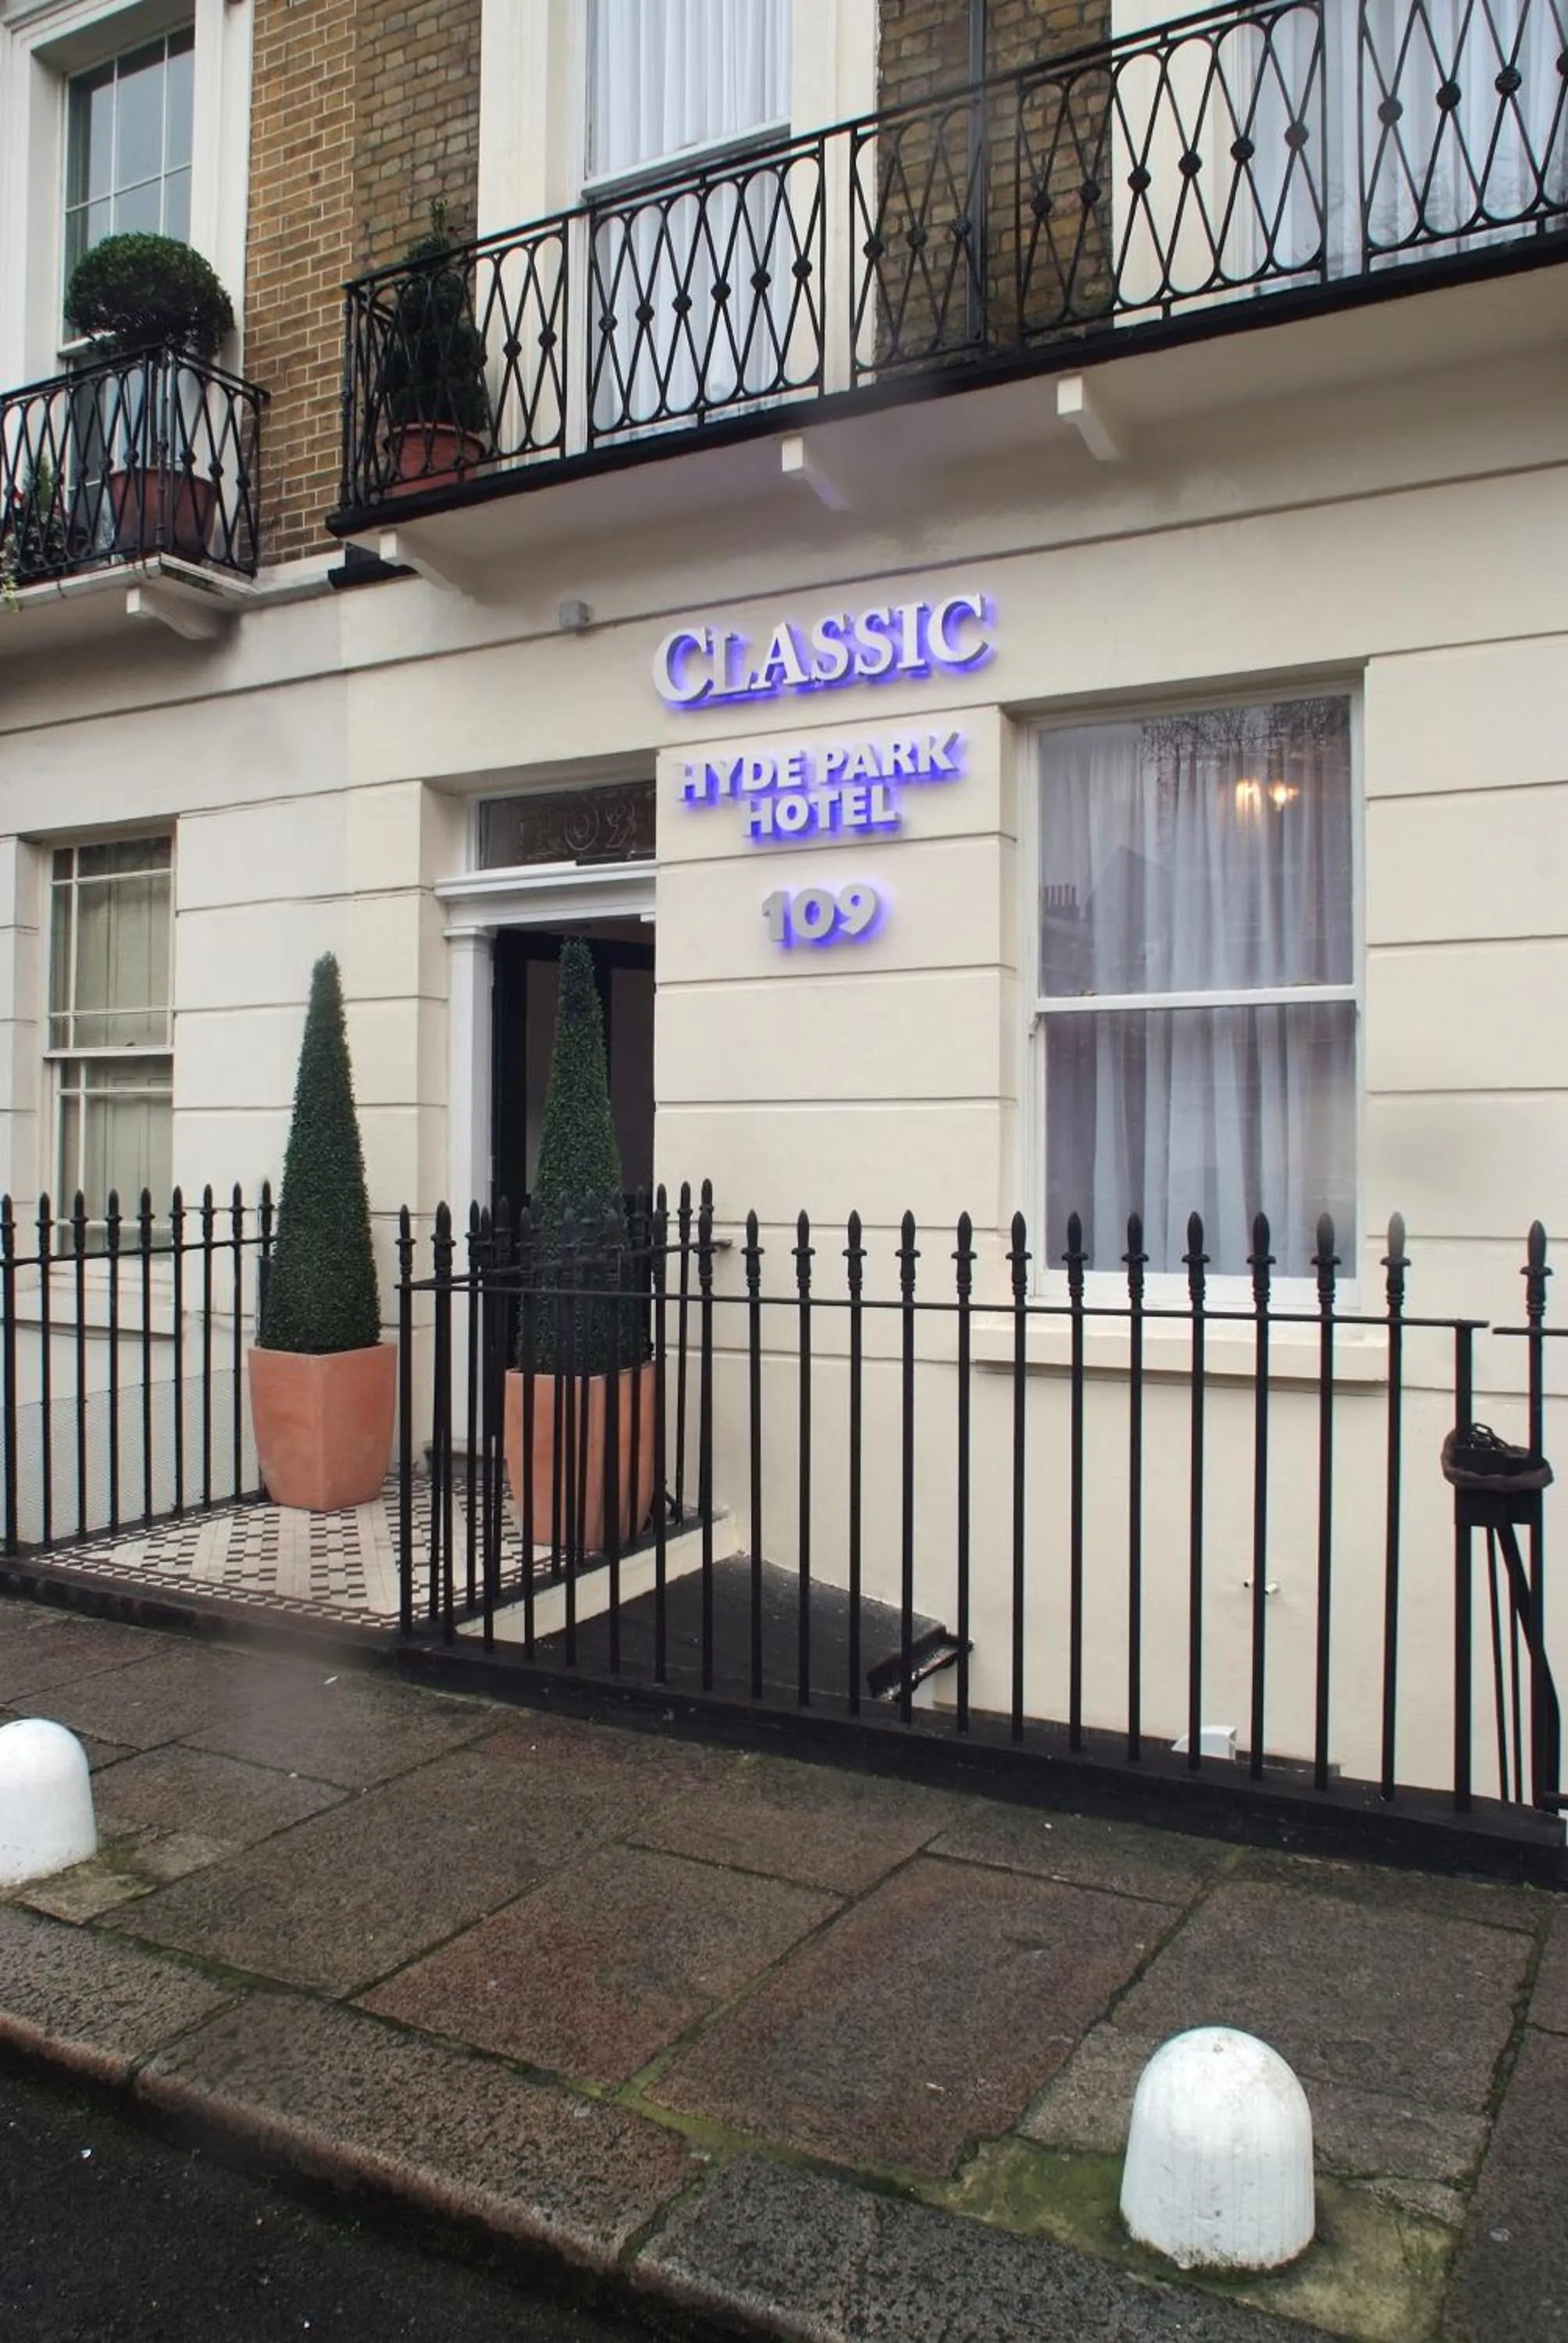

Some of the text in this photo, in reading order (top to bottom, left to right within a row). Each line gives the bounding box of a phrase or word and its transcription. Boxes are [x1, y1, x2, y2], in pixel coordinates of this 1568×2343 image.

[652, 593, 989, 703] CLASSIC
[679, 731, 960, 801] HYDE PARK
[743, 784, 901, 836] HOTEL
[761, 883, 880, 943] 109
